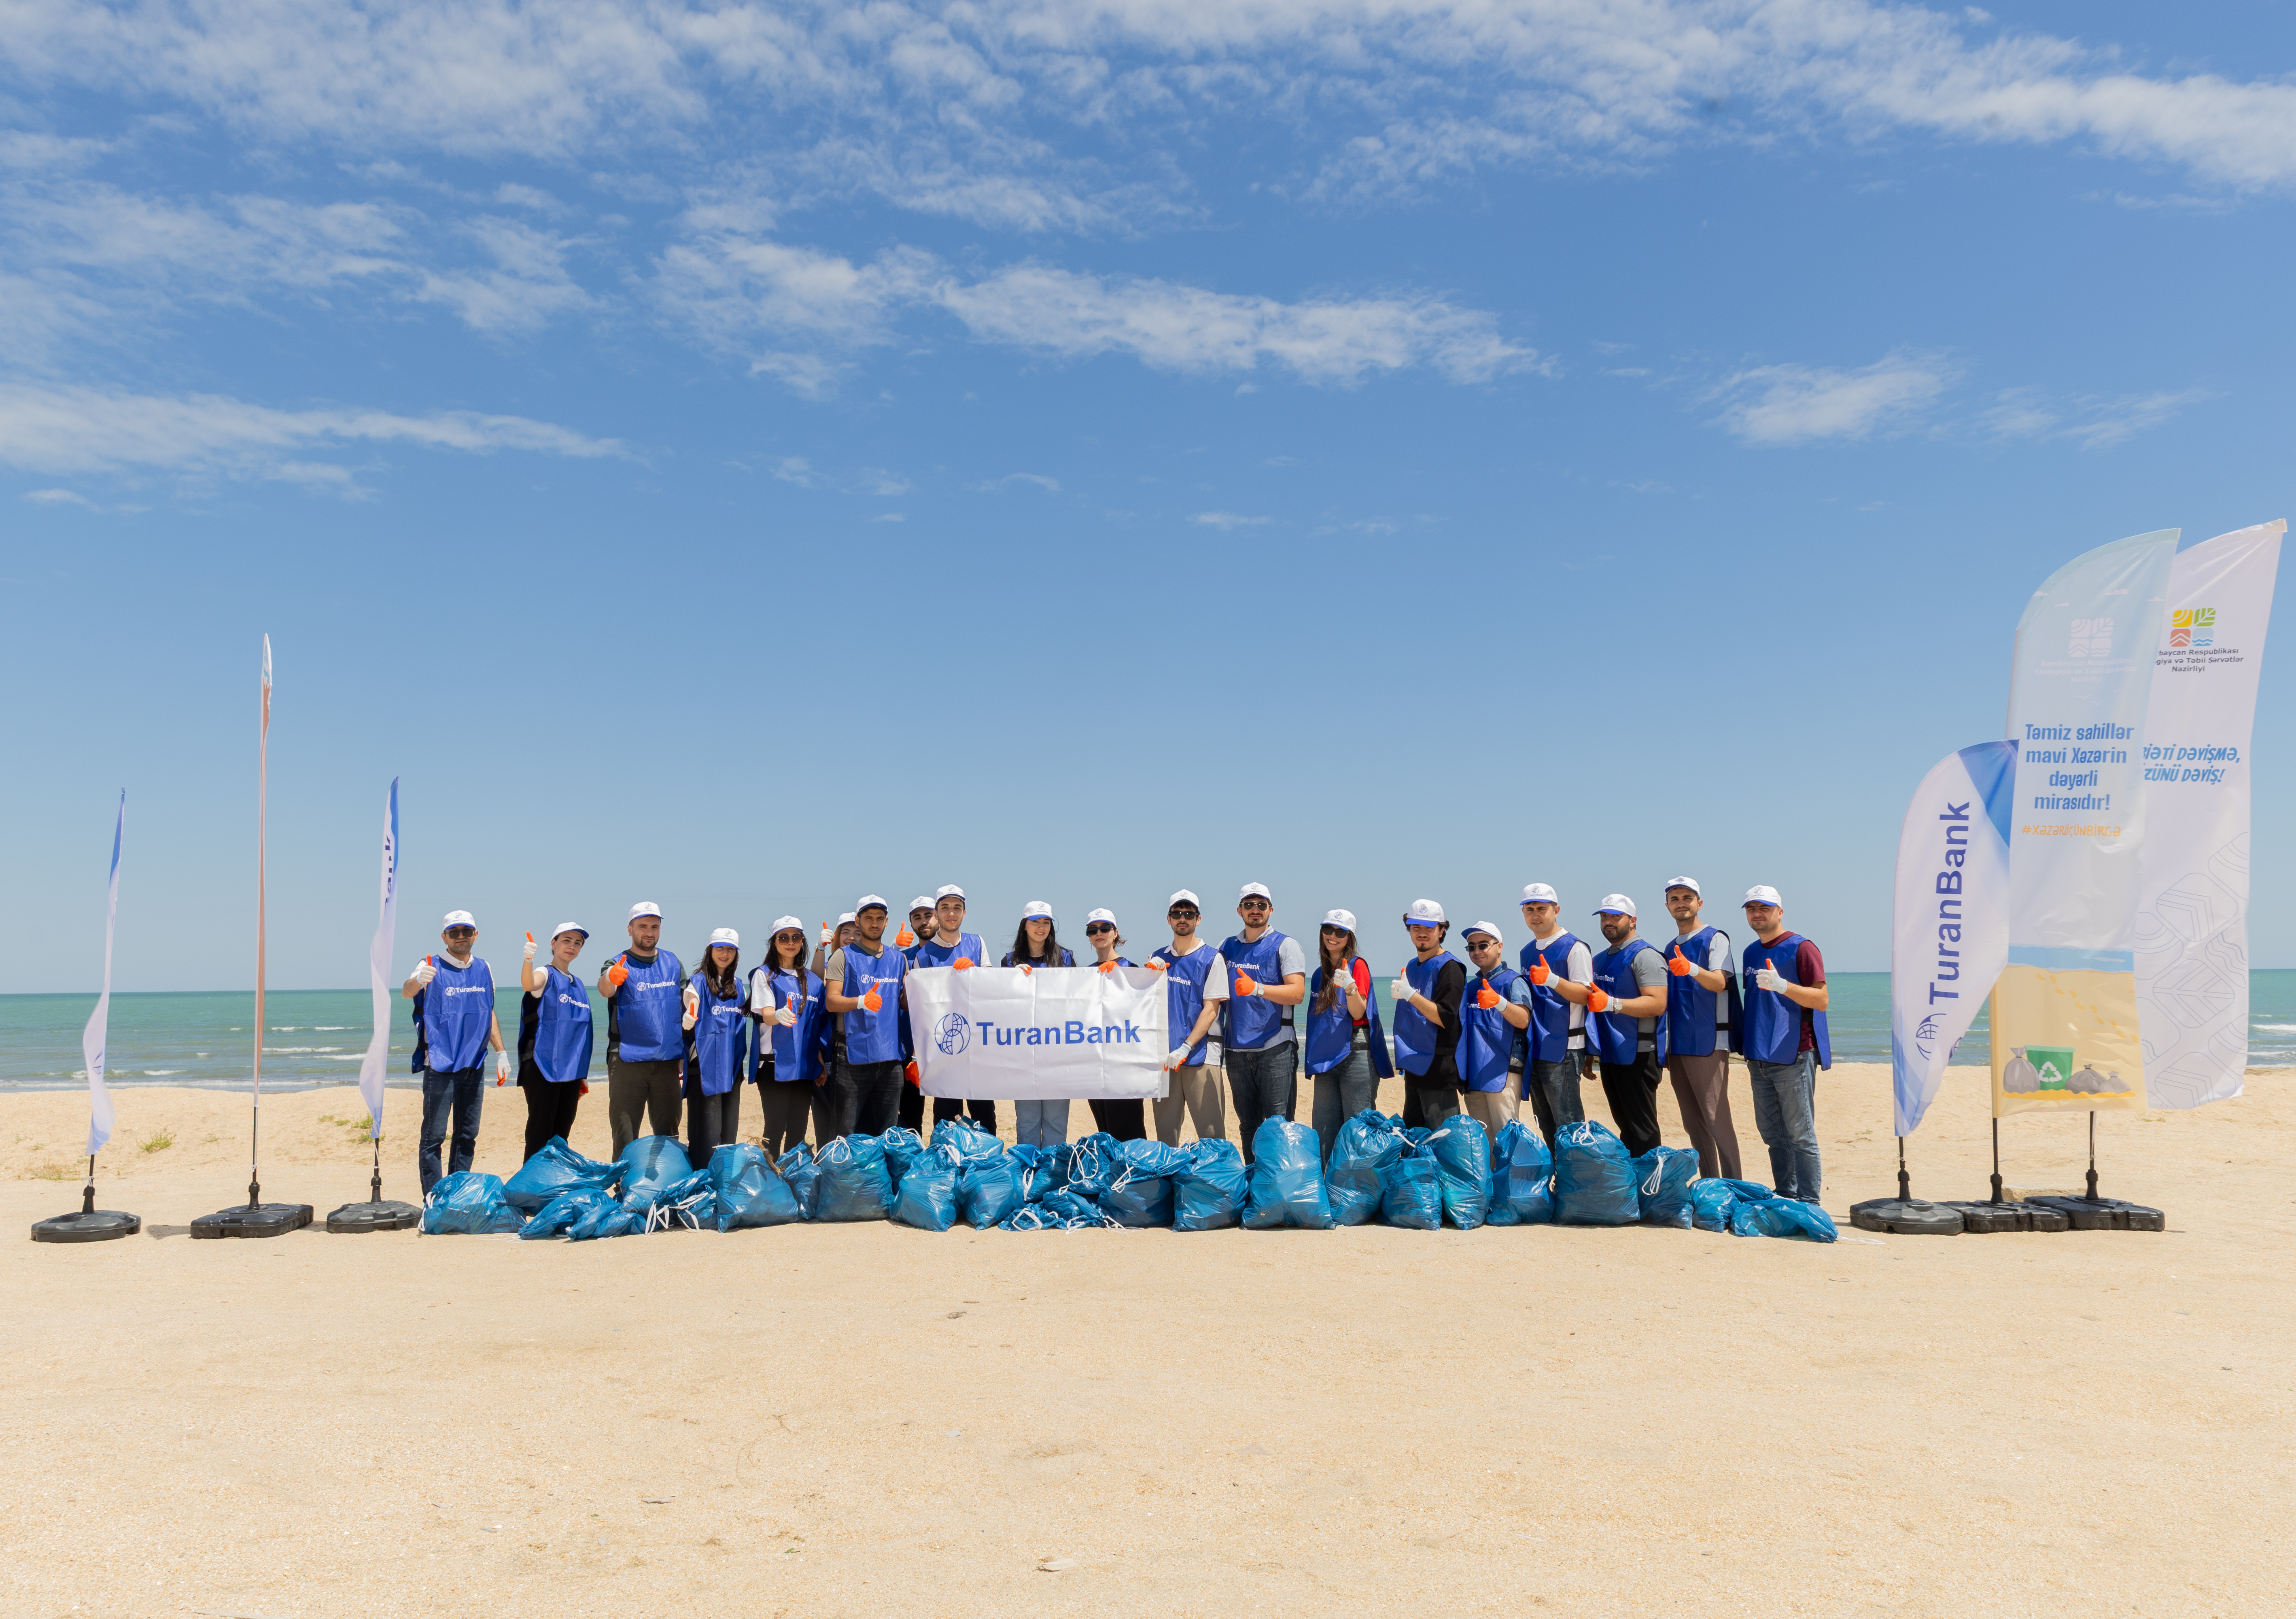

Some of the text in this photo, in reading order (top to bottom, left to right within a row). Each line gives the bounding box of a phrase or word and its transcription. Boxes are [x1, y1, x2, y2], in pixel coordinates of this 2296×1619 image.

[2087, 658, 2132, 666] Respublikası
[2025, 723, 2134, 740] Təmiz sahillər
[2026, 747, 2127, 763] mavi Xəzərin
[2176, 744, 2241, 764] DƏYİŞMƏ,
[2049, 770, 2098, 790] dəyərli
[2143, 763, 2226, 785] ZÜNÜ DƏYİŞ!
[2034, 793, 2110, 810] mirasıdır!
[1929, 801, 1970, 1005] TuranBank
[1231, 962, 1260, 970] TuranBank
[646, 980, 675, 988] TuranBank
[1167, 976, 1191, 986] ranBank
[1595, 974, 1615, 983] TuranBank
[568, 996, 590, 1009] TuranBank
[796, 993, 818, 1003] TunBank
[976, 1020, 1141, 1045] TuranBank
